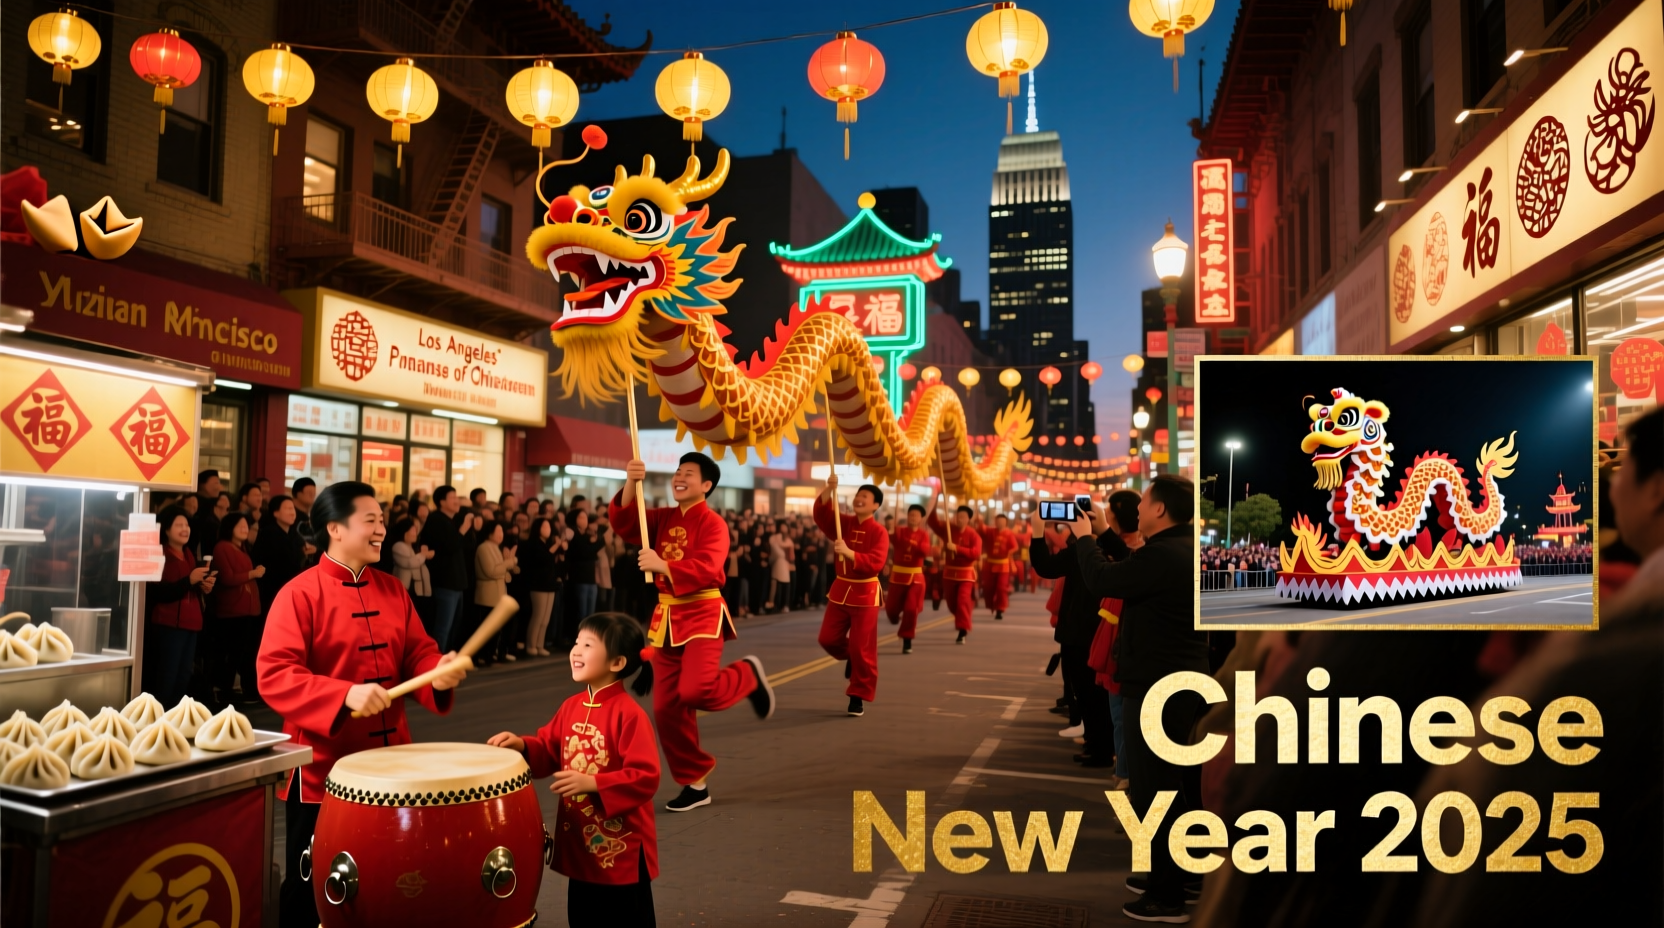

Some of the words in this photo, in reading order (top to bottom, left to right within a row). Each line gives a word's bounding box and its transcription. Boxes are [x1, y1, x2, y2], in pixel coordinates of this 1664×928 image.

[1462, 166, 1500, 279] 福
[418, 328, 441, 350] Los
[454, 365, 469, 382] of
[21, 392, 72, 449] 福
[128, 407, 171, 458] 福
